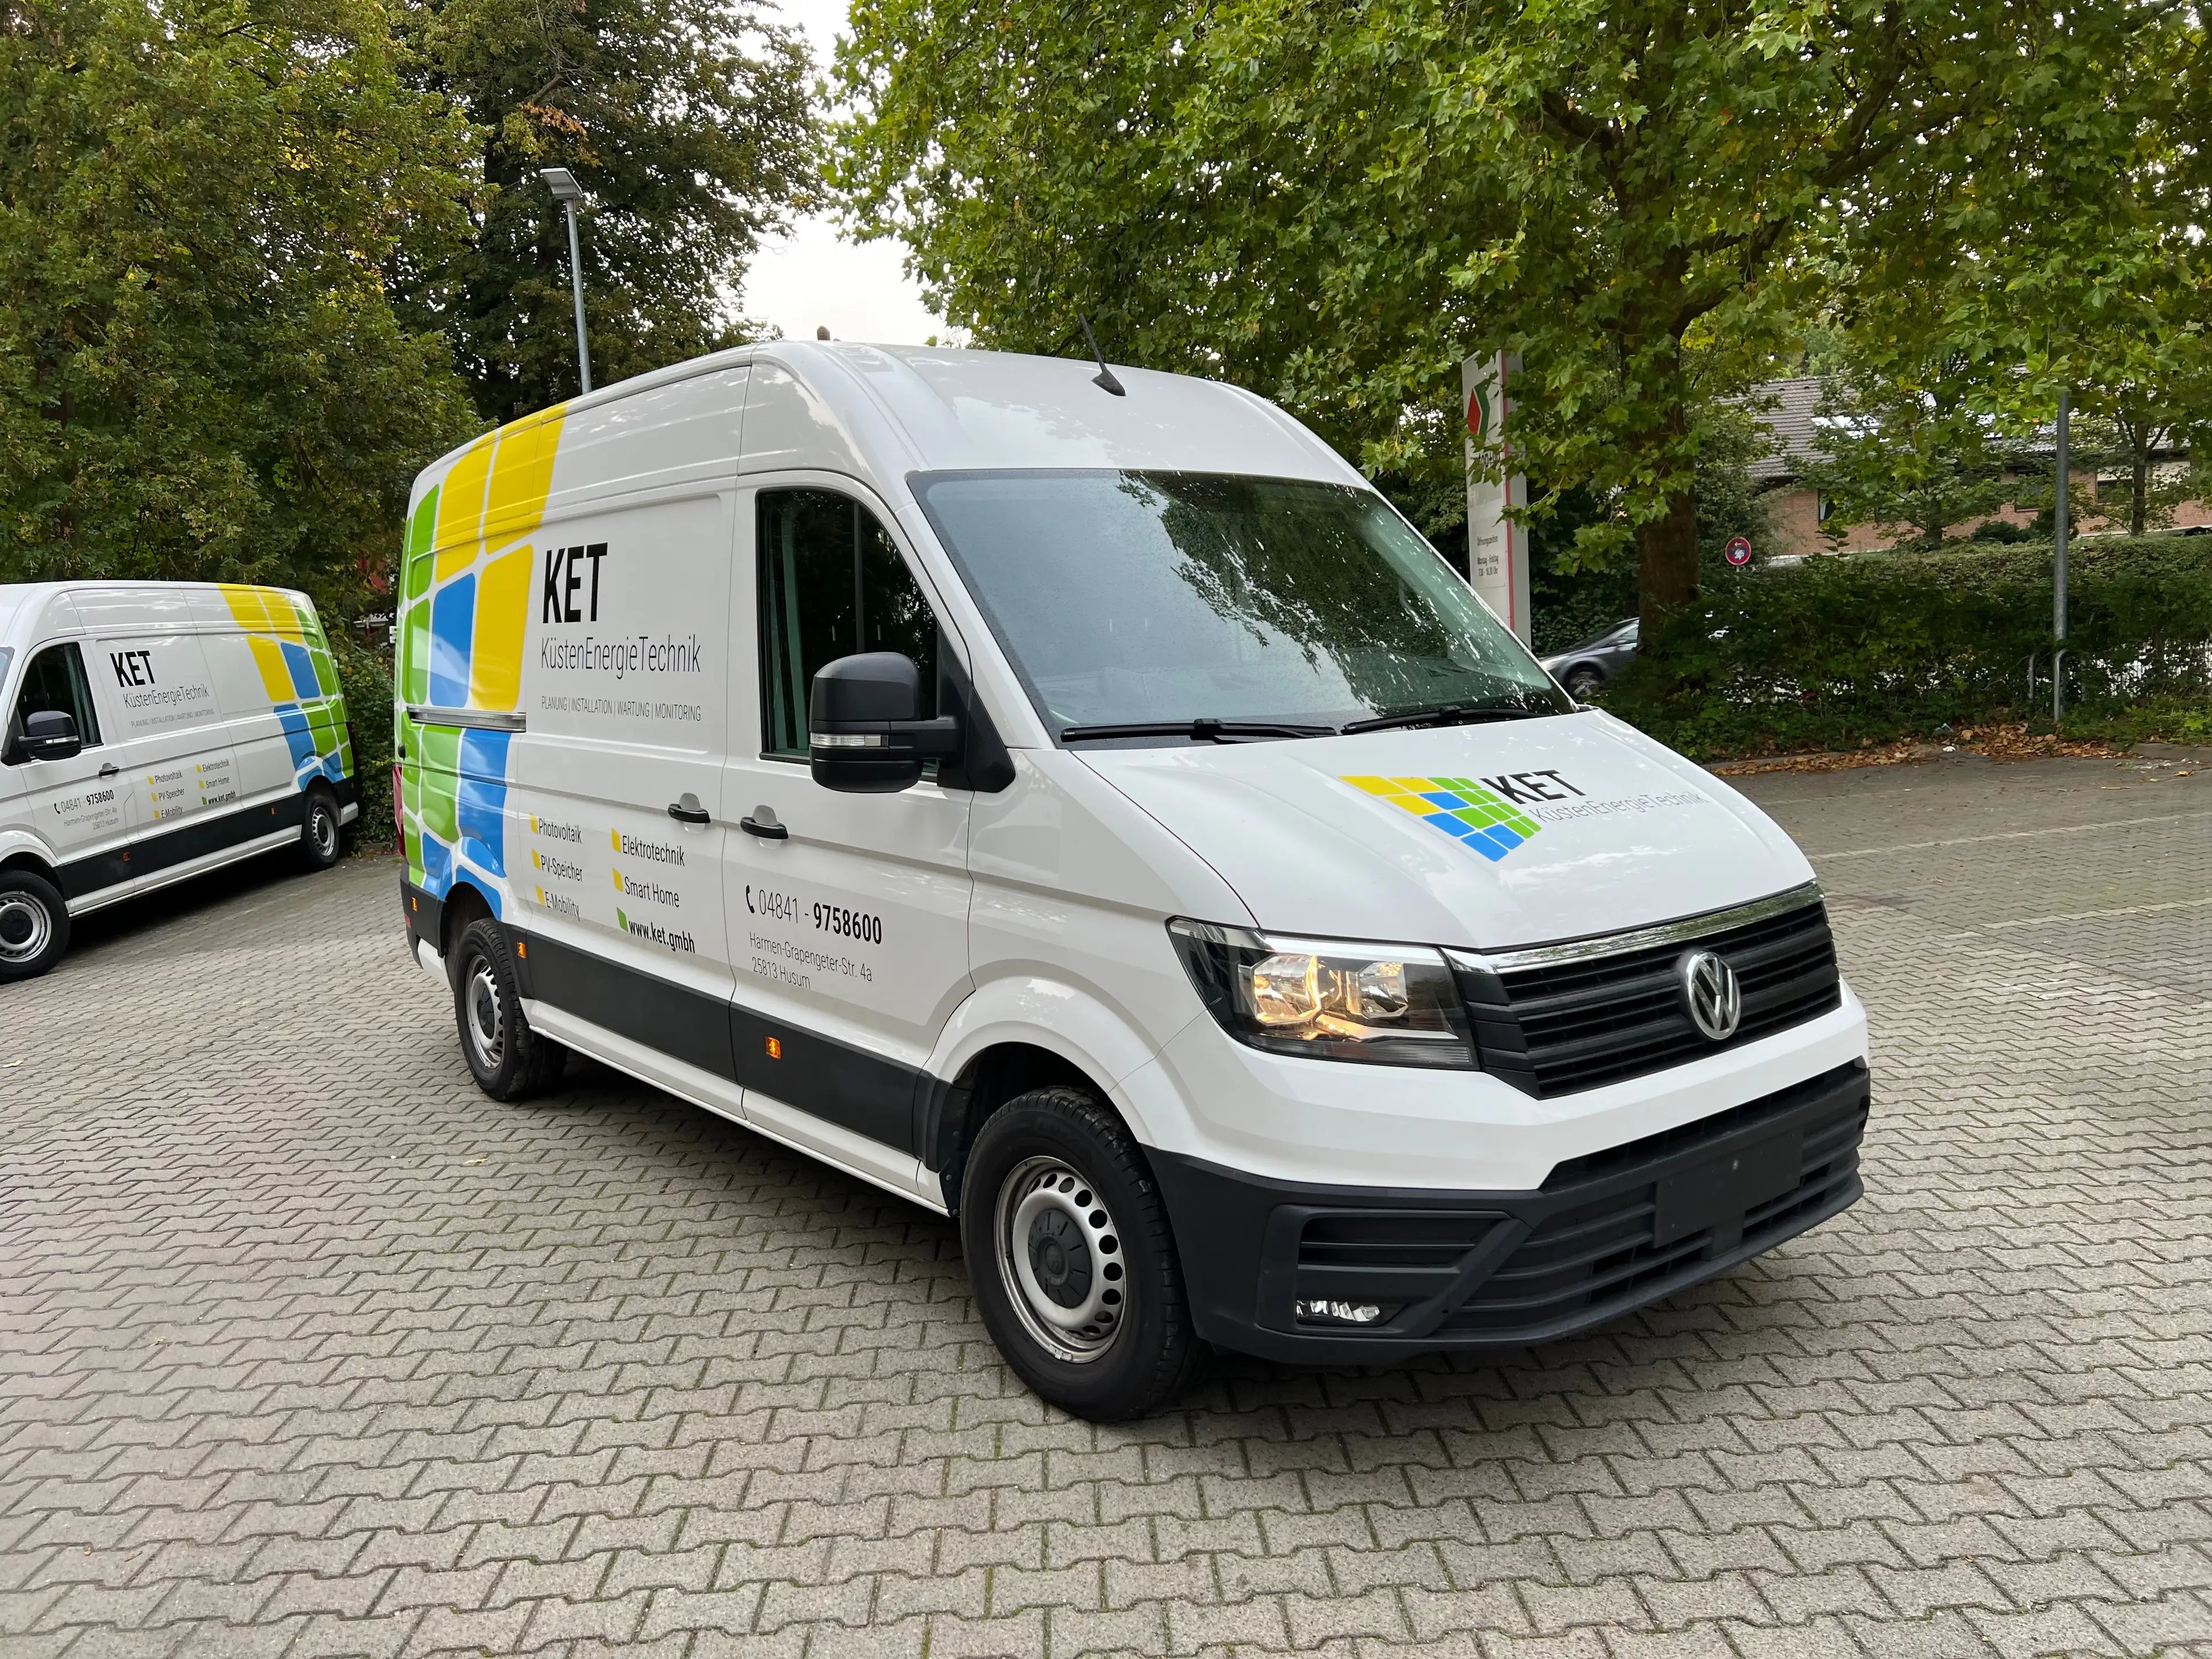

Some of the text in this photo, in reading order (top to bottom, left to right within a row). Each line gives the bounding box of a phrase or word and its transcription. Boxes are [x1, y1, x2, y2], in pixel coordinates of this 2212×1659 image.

[542, 542, 608, 624] KET
[109, 650, 156, 687] KET
[541, 634, 701, 680] KüstenEnergieTechnik
[123, 683, 210, 709] KüstenEnergieTechnik
[541, 695, 567, 711] PLANUNG
[571, 698, 612, 714] INSTALLATION
[618, 700, 650, 718] WARTUNG
[655, 703, 701, 721] MONITORING
[202, 759, 230, 772] Elektrotechnik
[158, 787, 185, 801] PV-Speicher
[205, 777, 230, 789] Smart Home
[208, 790, 236, 805] www.ket.gmbh
[1479, 769, 1587, 805] KET
[60, 797, 82, 812] 04841
[86, 789, 114, 806] 9758600
[161, 806, 183, 819] E-Mobility
[1528, 791, 1710, 823] KüstenEnergieTechnik
[539, 817, 582, 843] Photovoltaik
[623, 835, 685, 867] Elektrotechnik
[540, 854, 582, 882] PV-Speicher
[545, 891, 581, 922] E-Mobility
[624, 876, 680, 908] Smart Home
[759, 889, 798, 924] 04841
[813, 902, 882, 945] 9758600
[628, 920, 696, 954] www.ket.gmbh
[749, 931, 873, 982] Harmen-Grapengeter-Str. 4a
[752, 956, 811, 990] 25813 Husum
